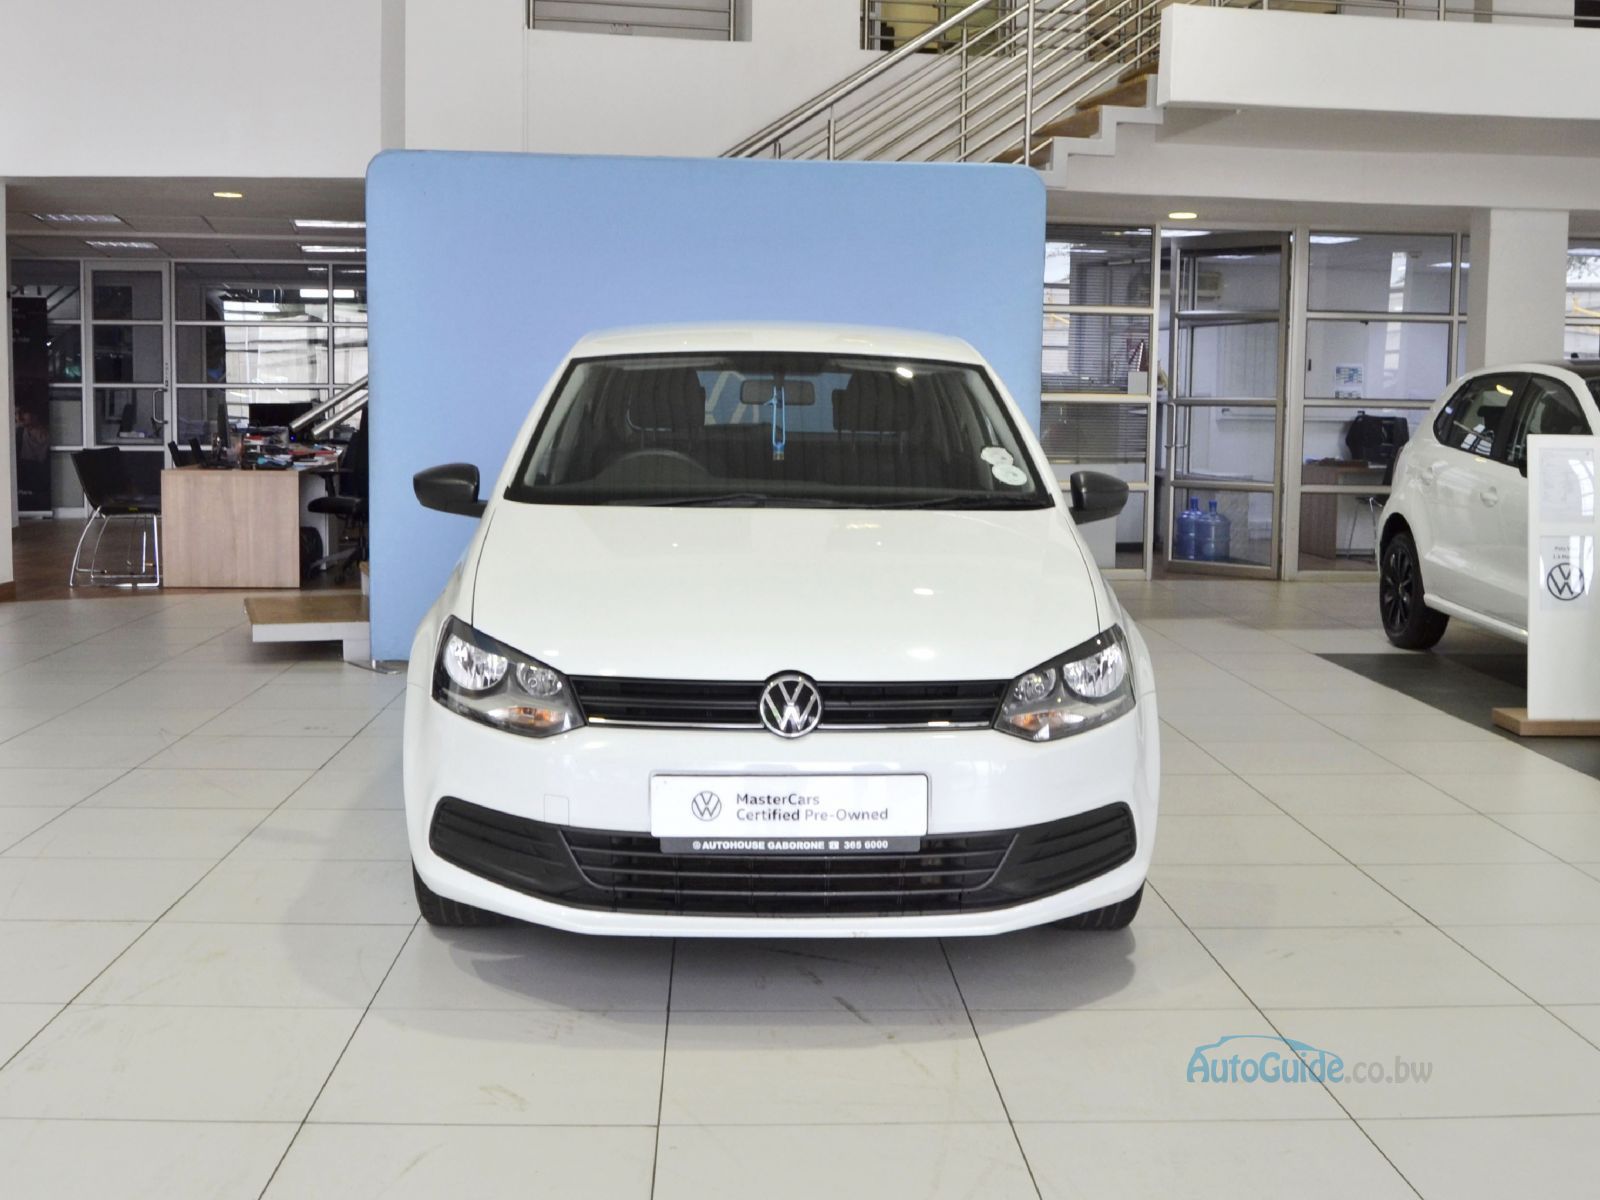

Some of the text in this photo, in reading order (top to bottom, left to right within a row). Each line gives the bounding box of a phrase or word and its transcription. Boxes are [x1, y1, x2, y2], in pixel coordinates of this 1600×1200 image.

[736, 793, 820, 806] MasterCars
[736, 807, 889, 821] Certified Pre-Owned
[702, 840, 765, 850] AUTOHOUSE
[767, 840, 825, 850] GABORONE
